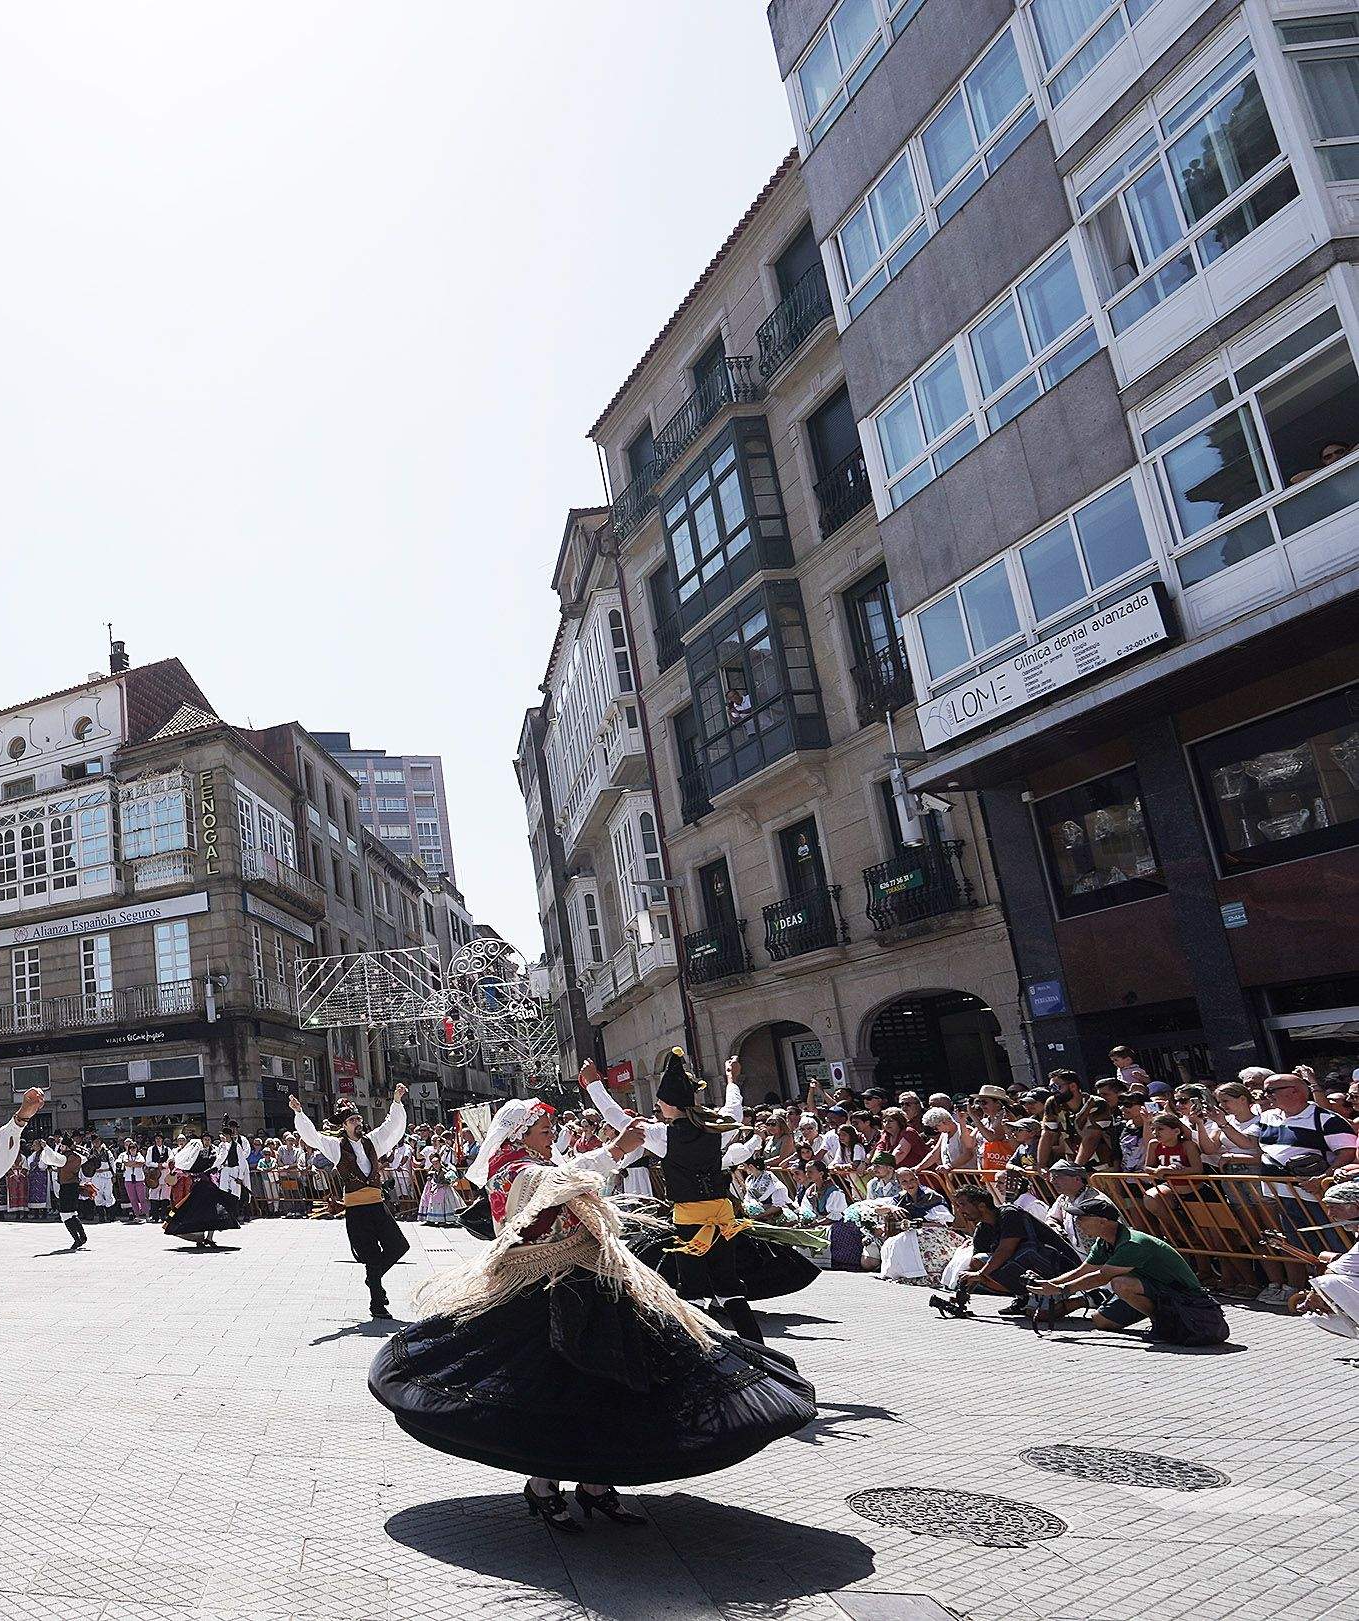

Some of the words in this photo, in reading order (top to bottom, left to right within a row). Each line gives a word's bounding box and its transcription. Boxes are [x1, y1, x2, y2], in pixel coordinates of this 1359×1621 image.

[1013, 645, 1052, 671] Clínica
[1054, 625, 1088, 651] dental
[1091, 594, 1150, 632] avanzada
[951, 673, 1013, 723] LOME
[198, 770, 220, 876] FENOGAL
[33, 923, 69, 938] Alianza
[72, 913, 117, 932] Española
[119, 906, 161, 924] Seguros
[773, 912, 803, 931] YDEAS
[825, 1016, 832, 1029] 3
[105, 1036, 126, 1044] VIAJES
[1158, 1155, 1183, 1167] 15
